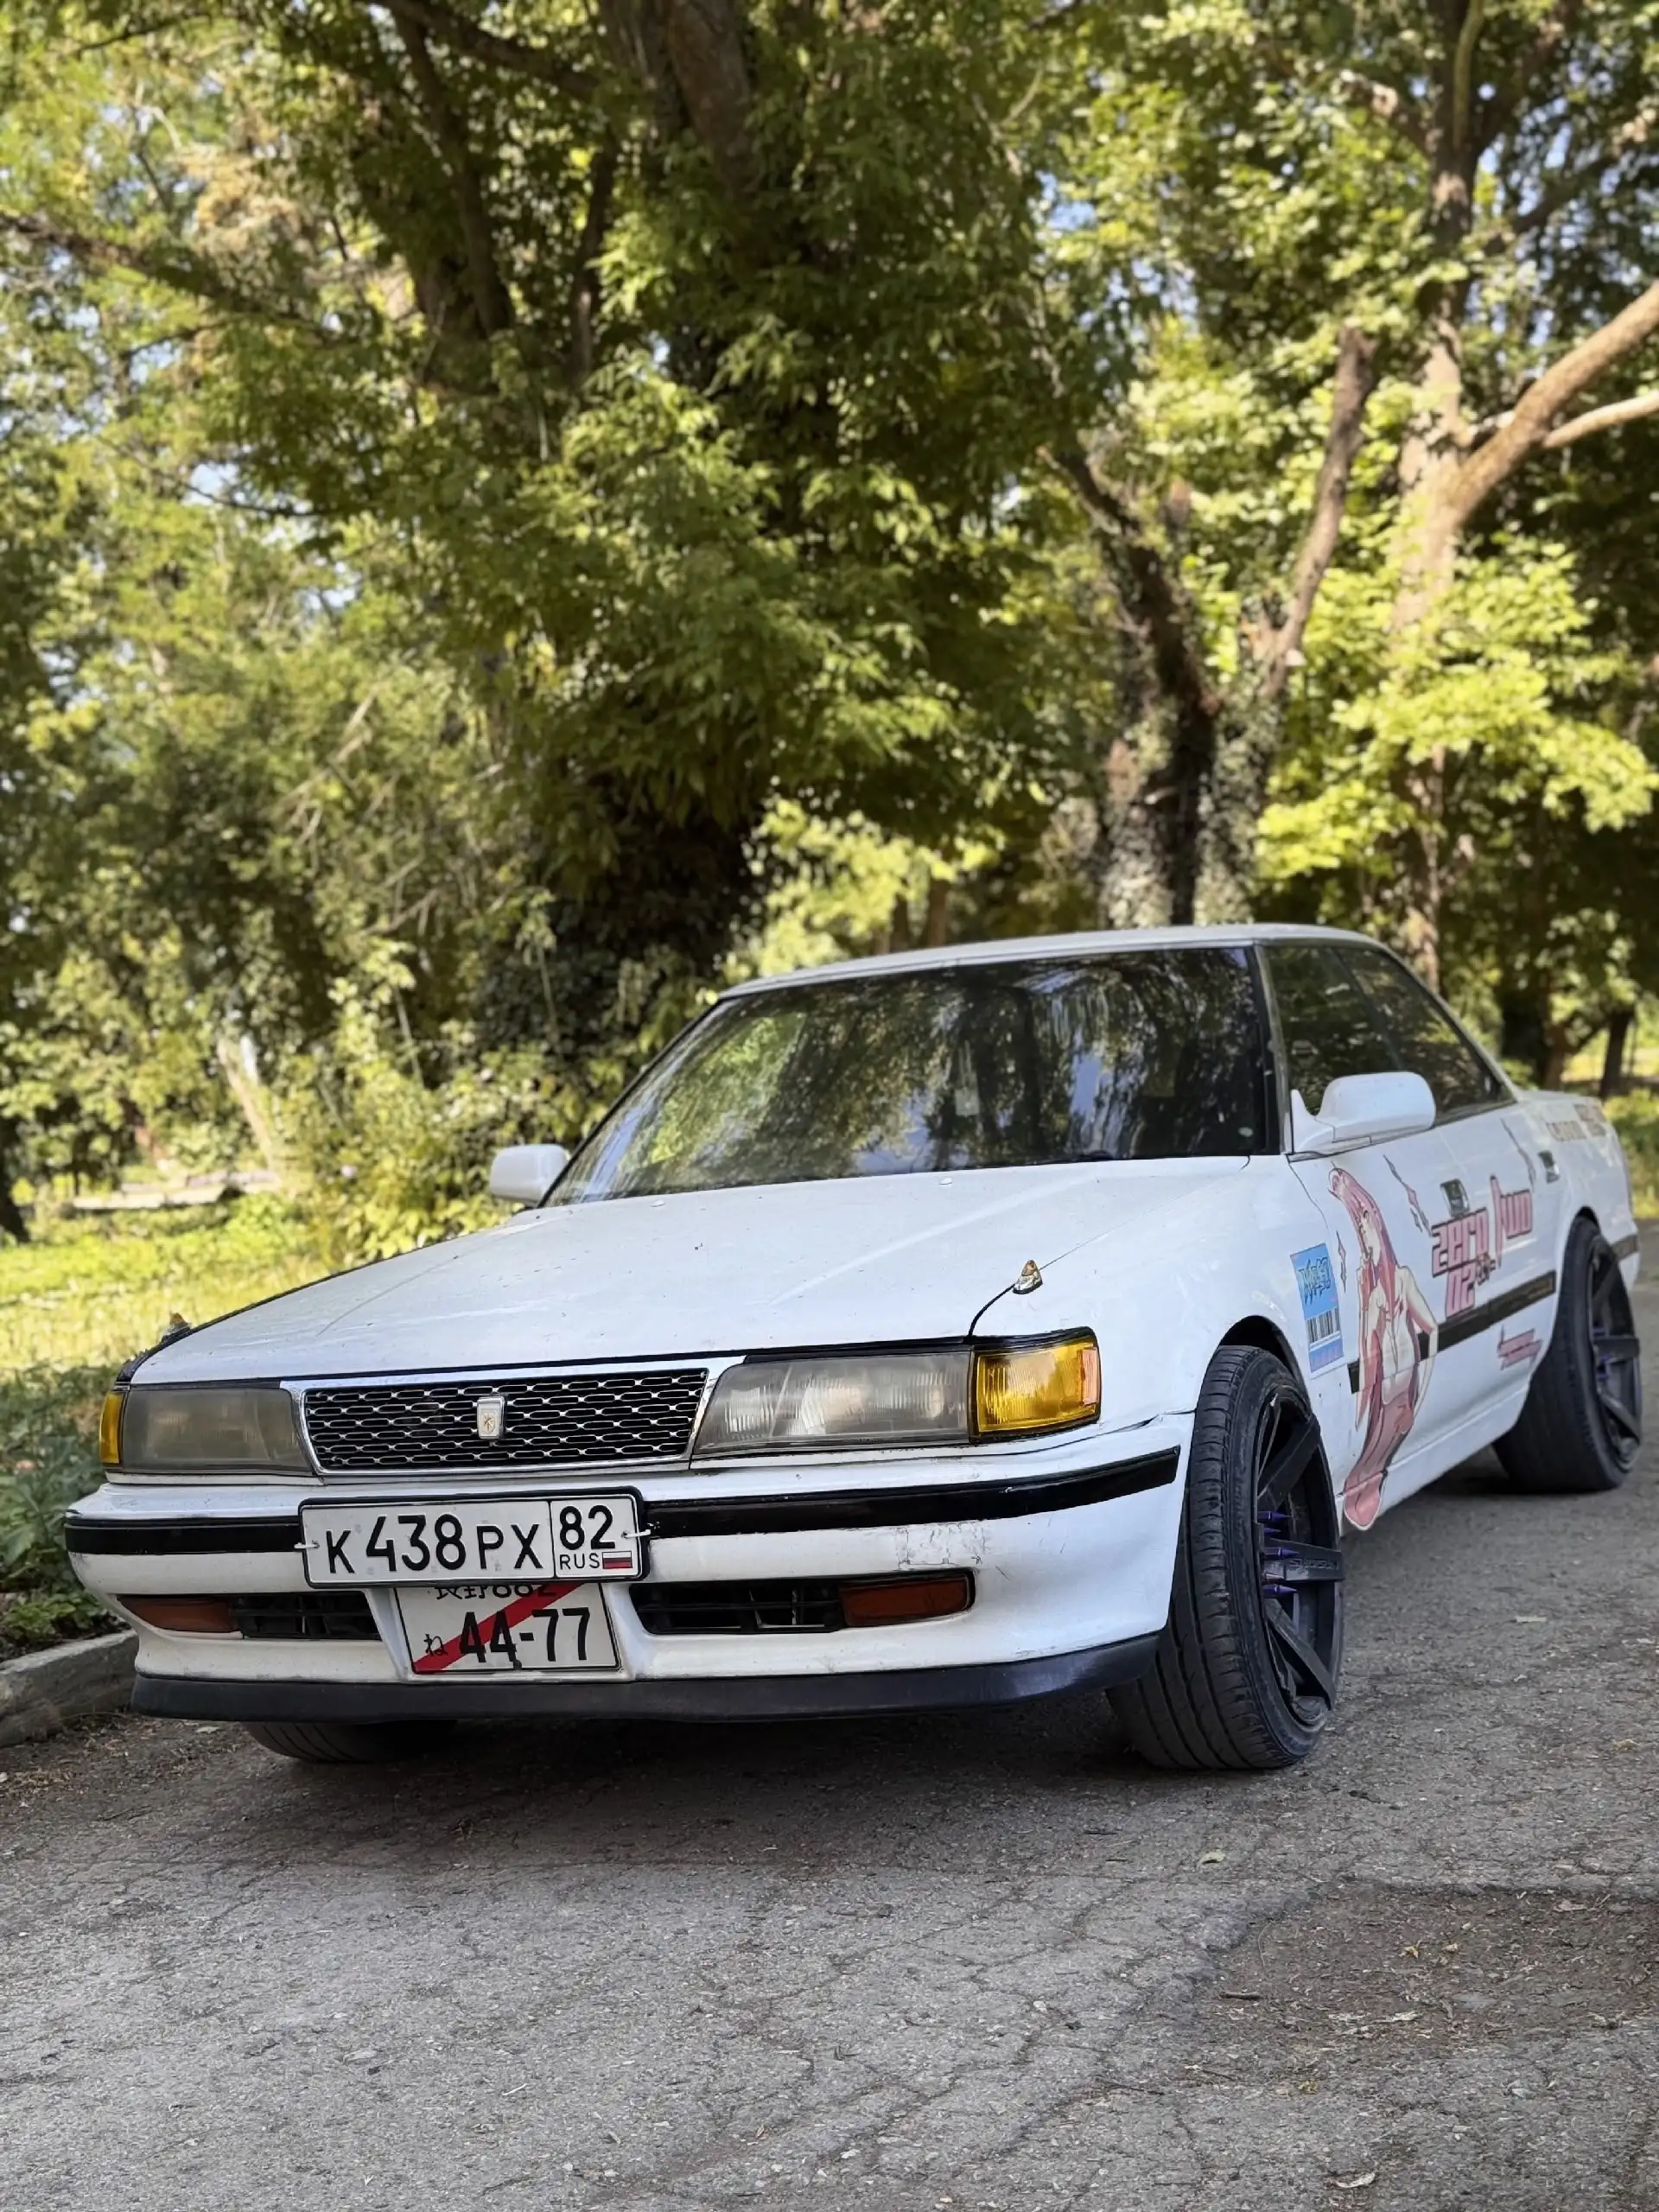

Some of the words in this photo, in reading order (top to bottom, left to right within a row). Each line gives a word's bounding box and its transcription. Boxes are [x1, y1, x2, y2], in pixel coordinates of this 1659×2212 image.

[559, 1505, 616, 1550] 82
[559, 1553, 600, 1571] RUS
[459, 1607, 591, 1663] 44-77
